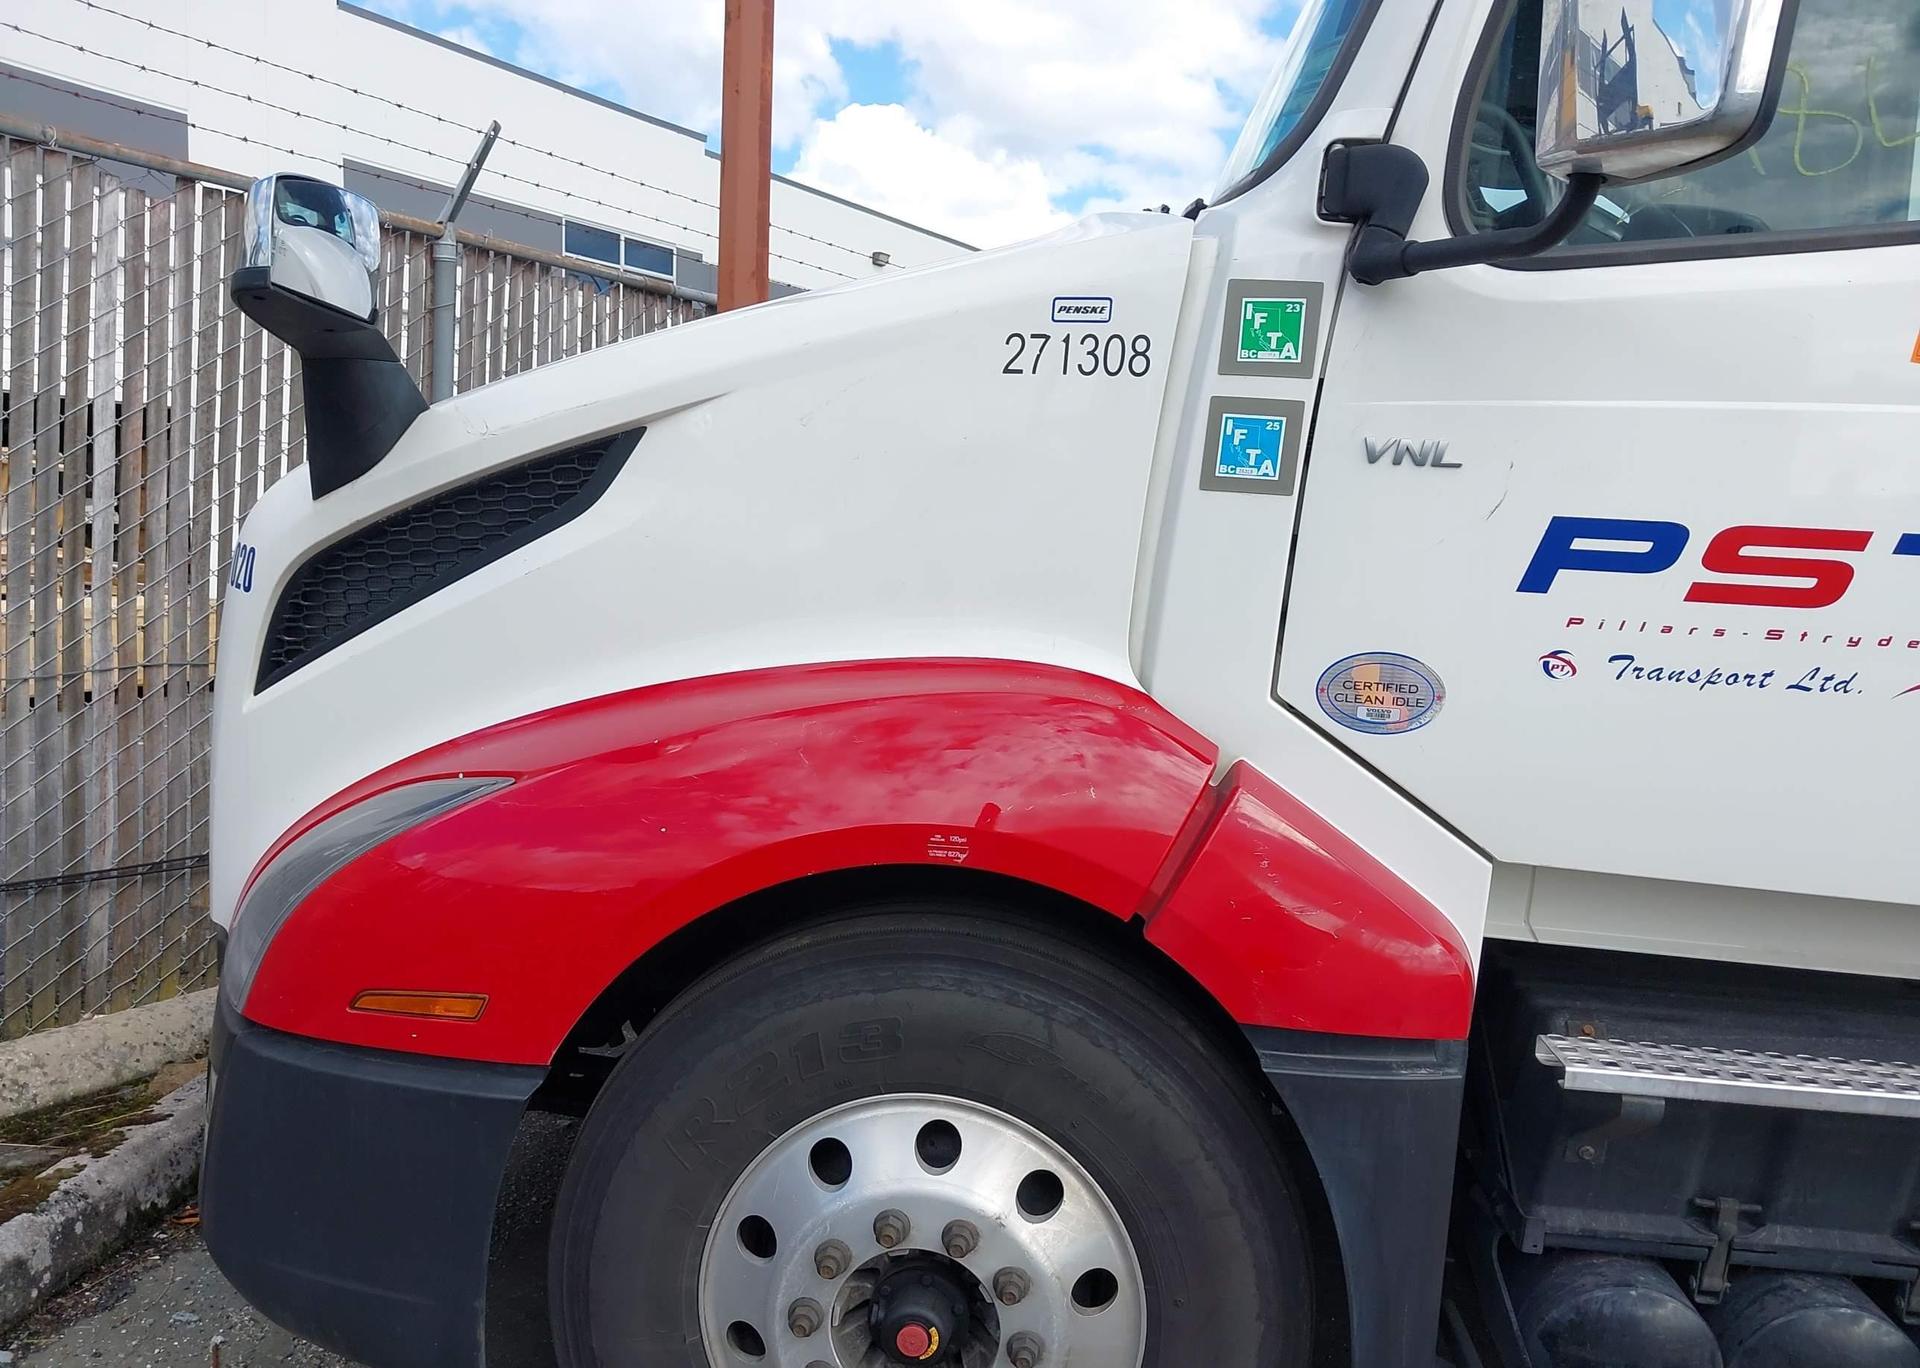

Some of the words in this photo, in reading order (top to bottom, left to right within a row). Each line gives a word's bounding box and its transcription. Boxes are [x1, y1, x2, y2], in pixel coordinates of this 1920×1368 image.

[1057, 305, 1108, 315] PENSKE
[1285, 303, 1301, 313] 23
[1002, 332, 1151, 378] 271308
[1241, 349, 1258, 359] BC
[1265, 421, 1280, 431] 25
[1364, 437, 1463, 468] VNL
[1219, 464, 1236, 474] BC
[1516, 515, 1920, 609] PS
[1566, 617, 1920, 649] Pillars-Stryde
[1550, 663, 1567, 672] PT
[1608, 655, 1776, 691] Transport
[1785, 667, 1864, 695] Ltd.
[1342, 680, 1419, 694] CERTIFIED
[1333, 693, 1385, 706] CLEAN
[1392, 697, 1426, 708] IDLE
